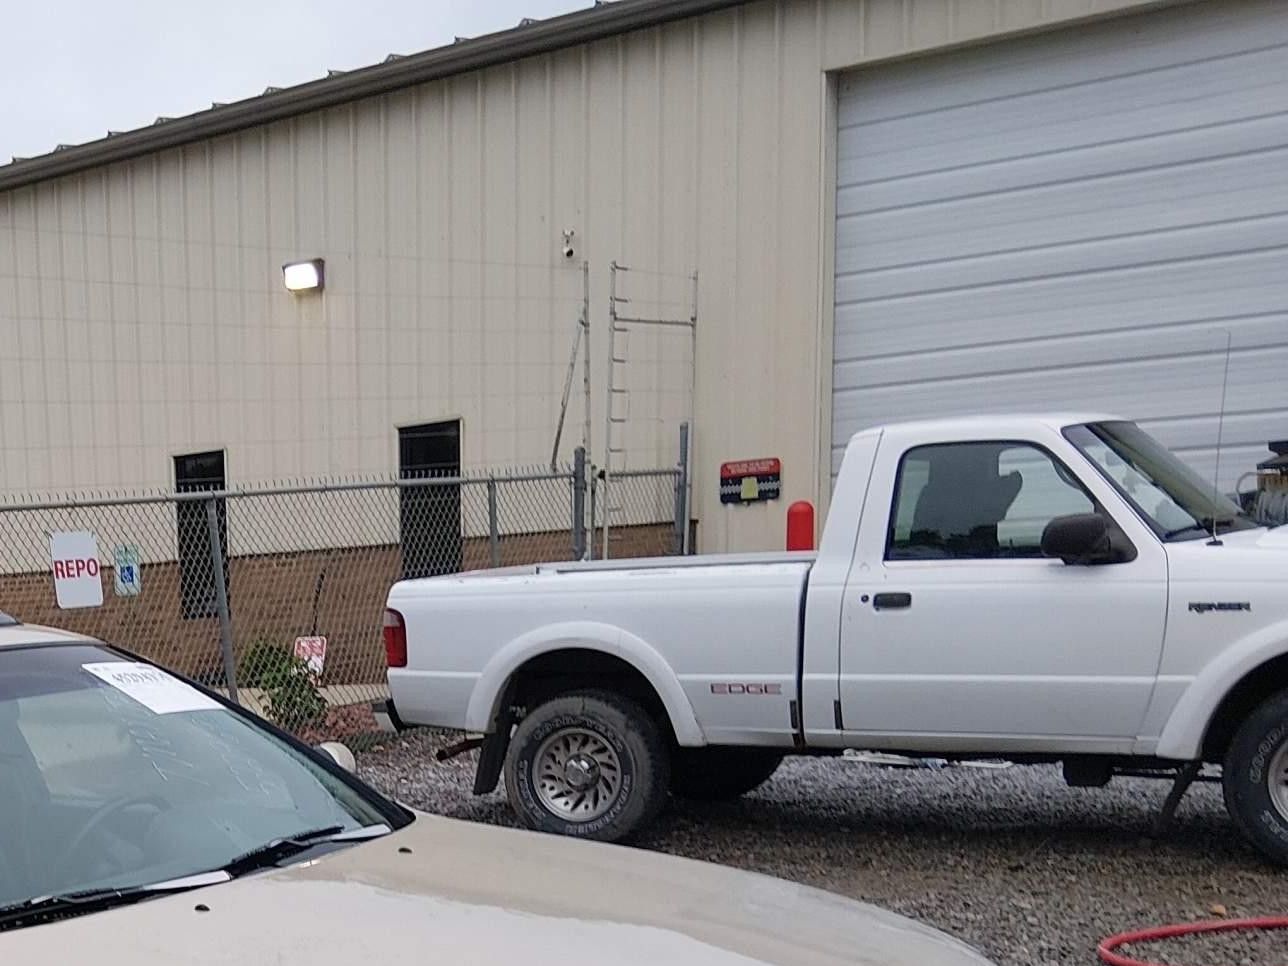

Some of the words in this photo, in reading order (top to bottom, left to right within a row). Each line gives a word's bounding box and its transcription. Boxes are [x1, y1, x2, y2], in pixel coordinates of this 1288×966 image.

[53, 557, 99, 579] REPO
[1187, 602, 1252, 613] RANGER
[710, 683, 782, 695] EDGE
